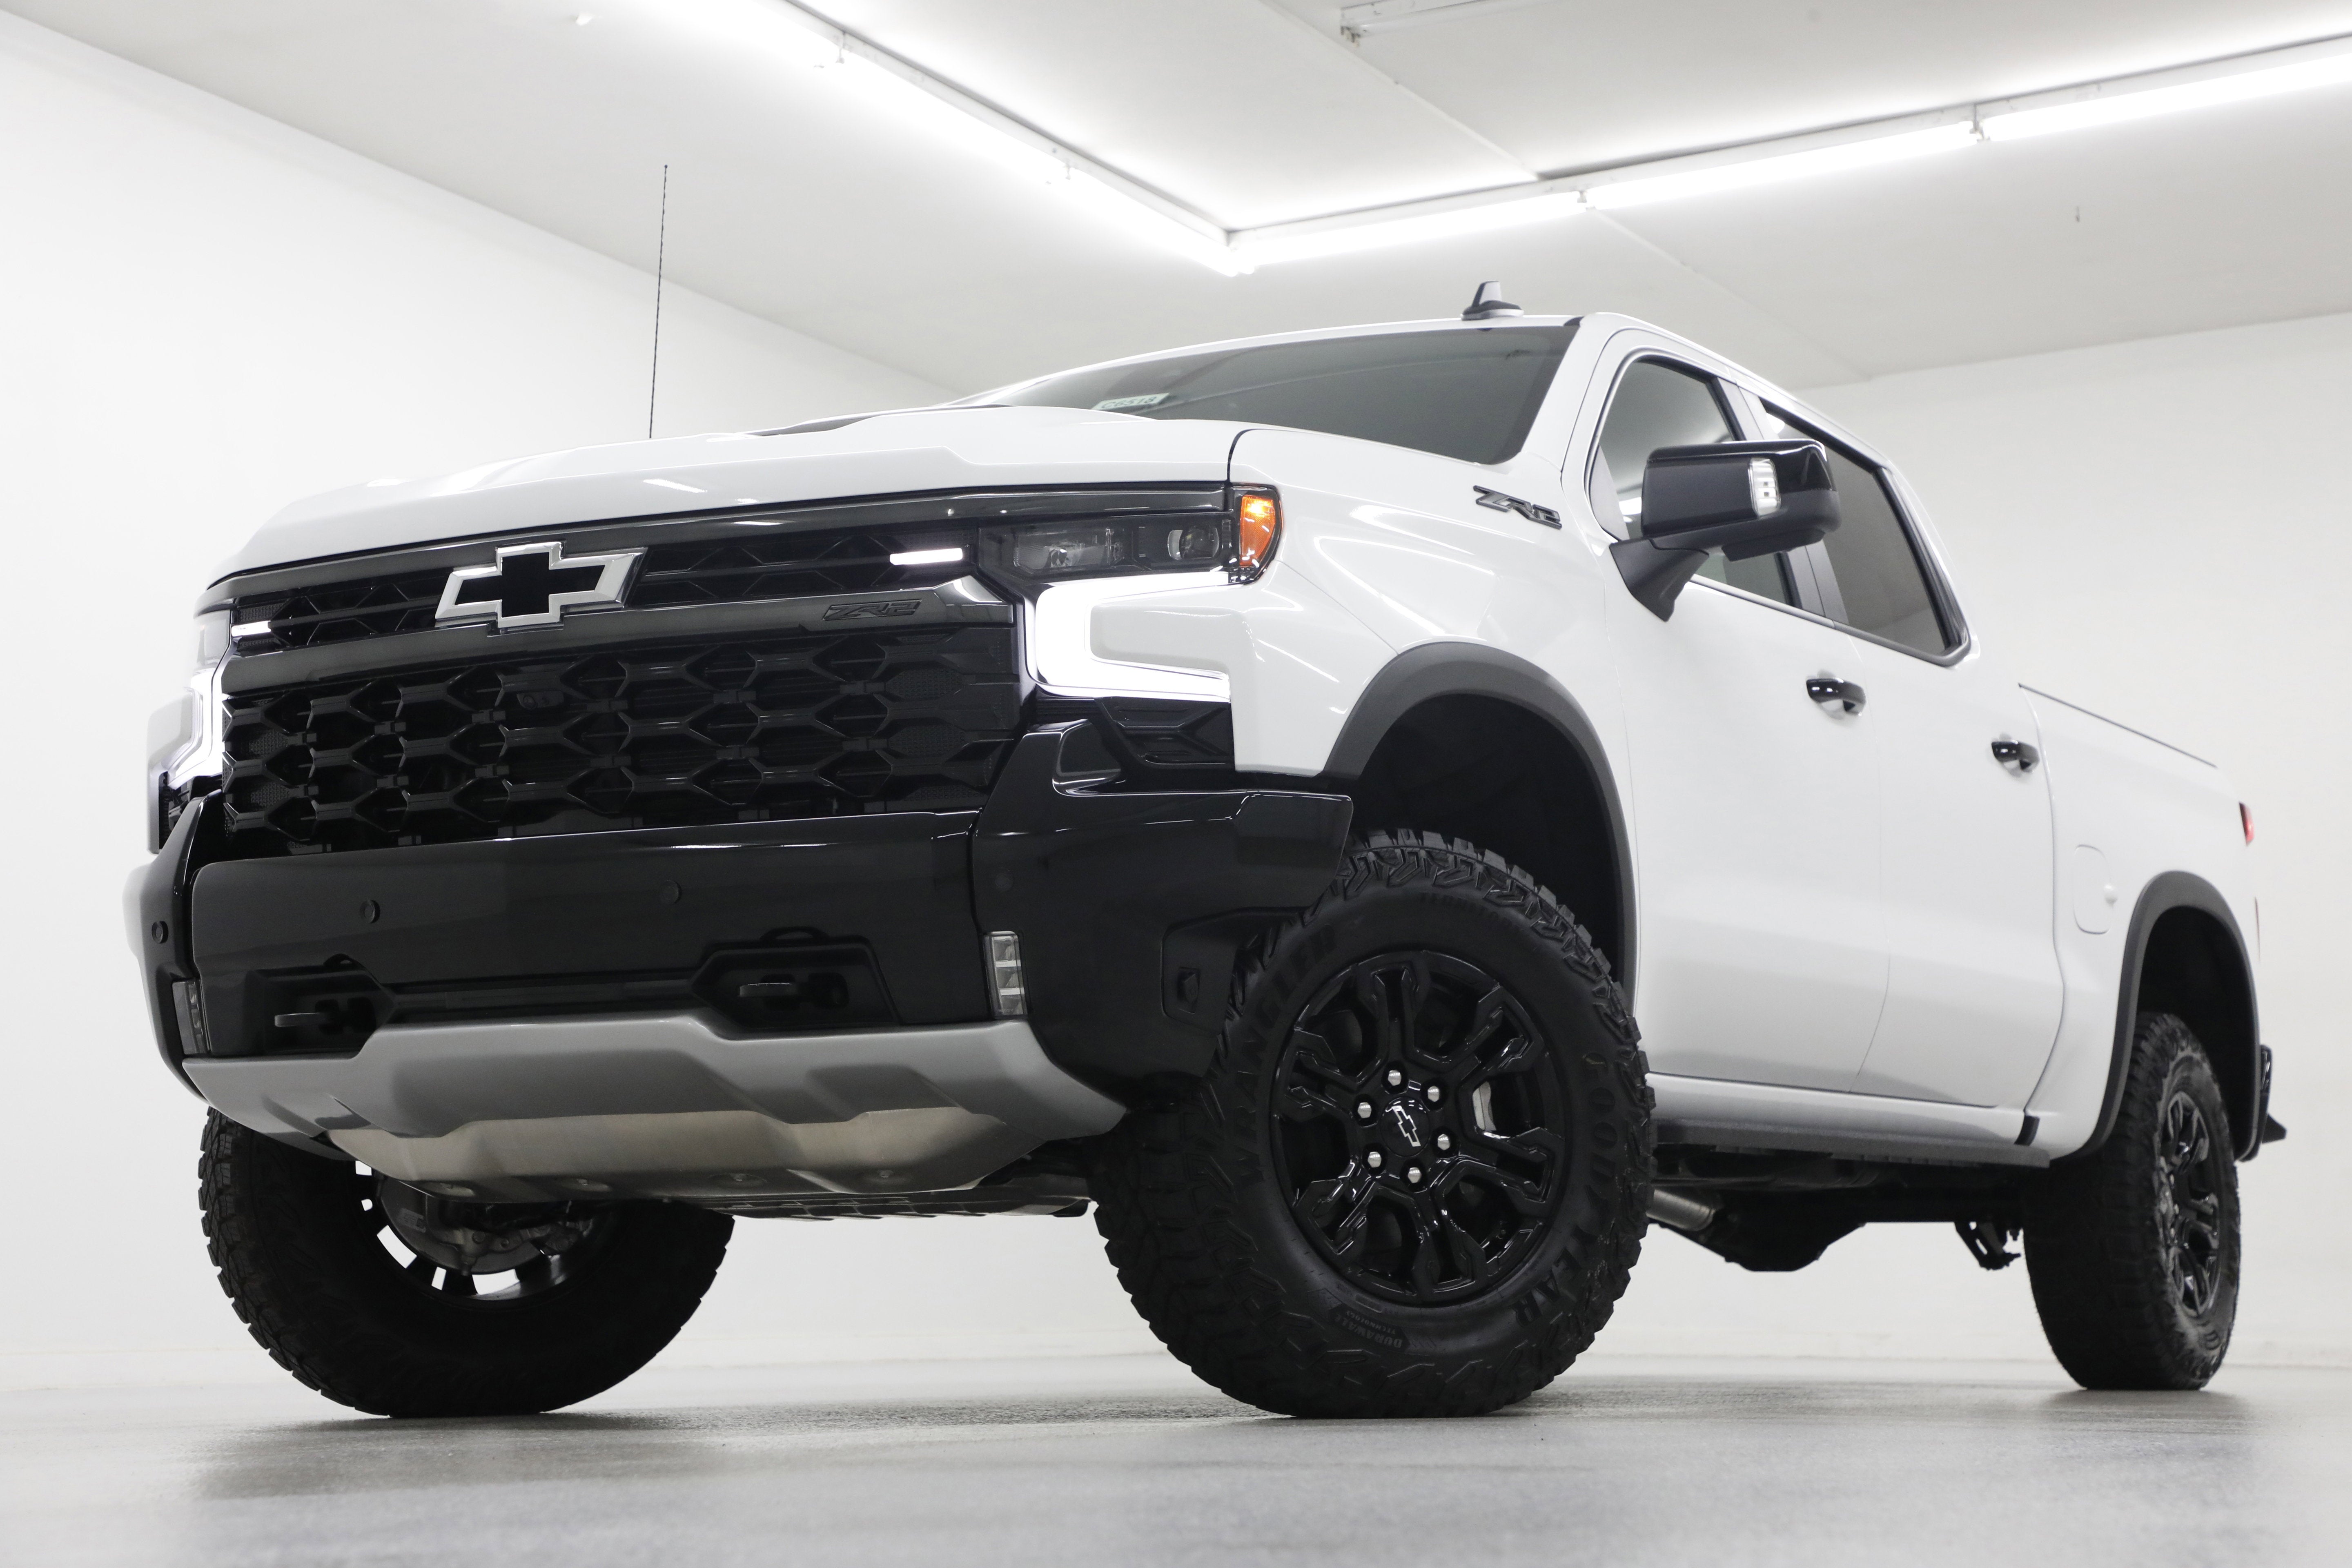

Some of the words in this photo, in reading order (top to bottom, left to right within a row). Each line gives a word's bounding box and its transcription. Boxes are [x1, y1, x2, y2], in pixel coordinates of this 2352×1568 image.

[1473, 485, 1562, 530] ZR2
[823, 599, 922, 621] ZR2
[1234, 923, 1336, 1187] WRANGLER
[1334, 1313, 1403, 1348] DURAWALL
[1345, 1310, 1396, 1335] TECHNOLOGY
